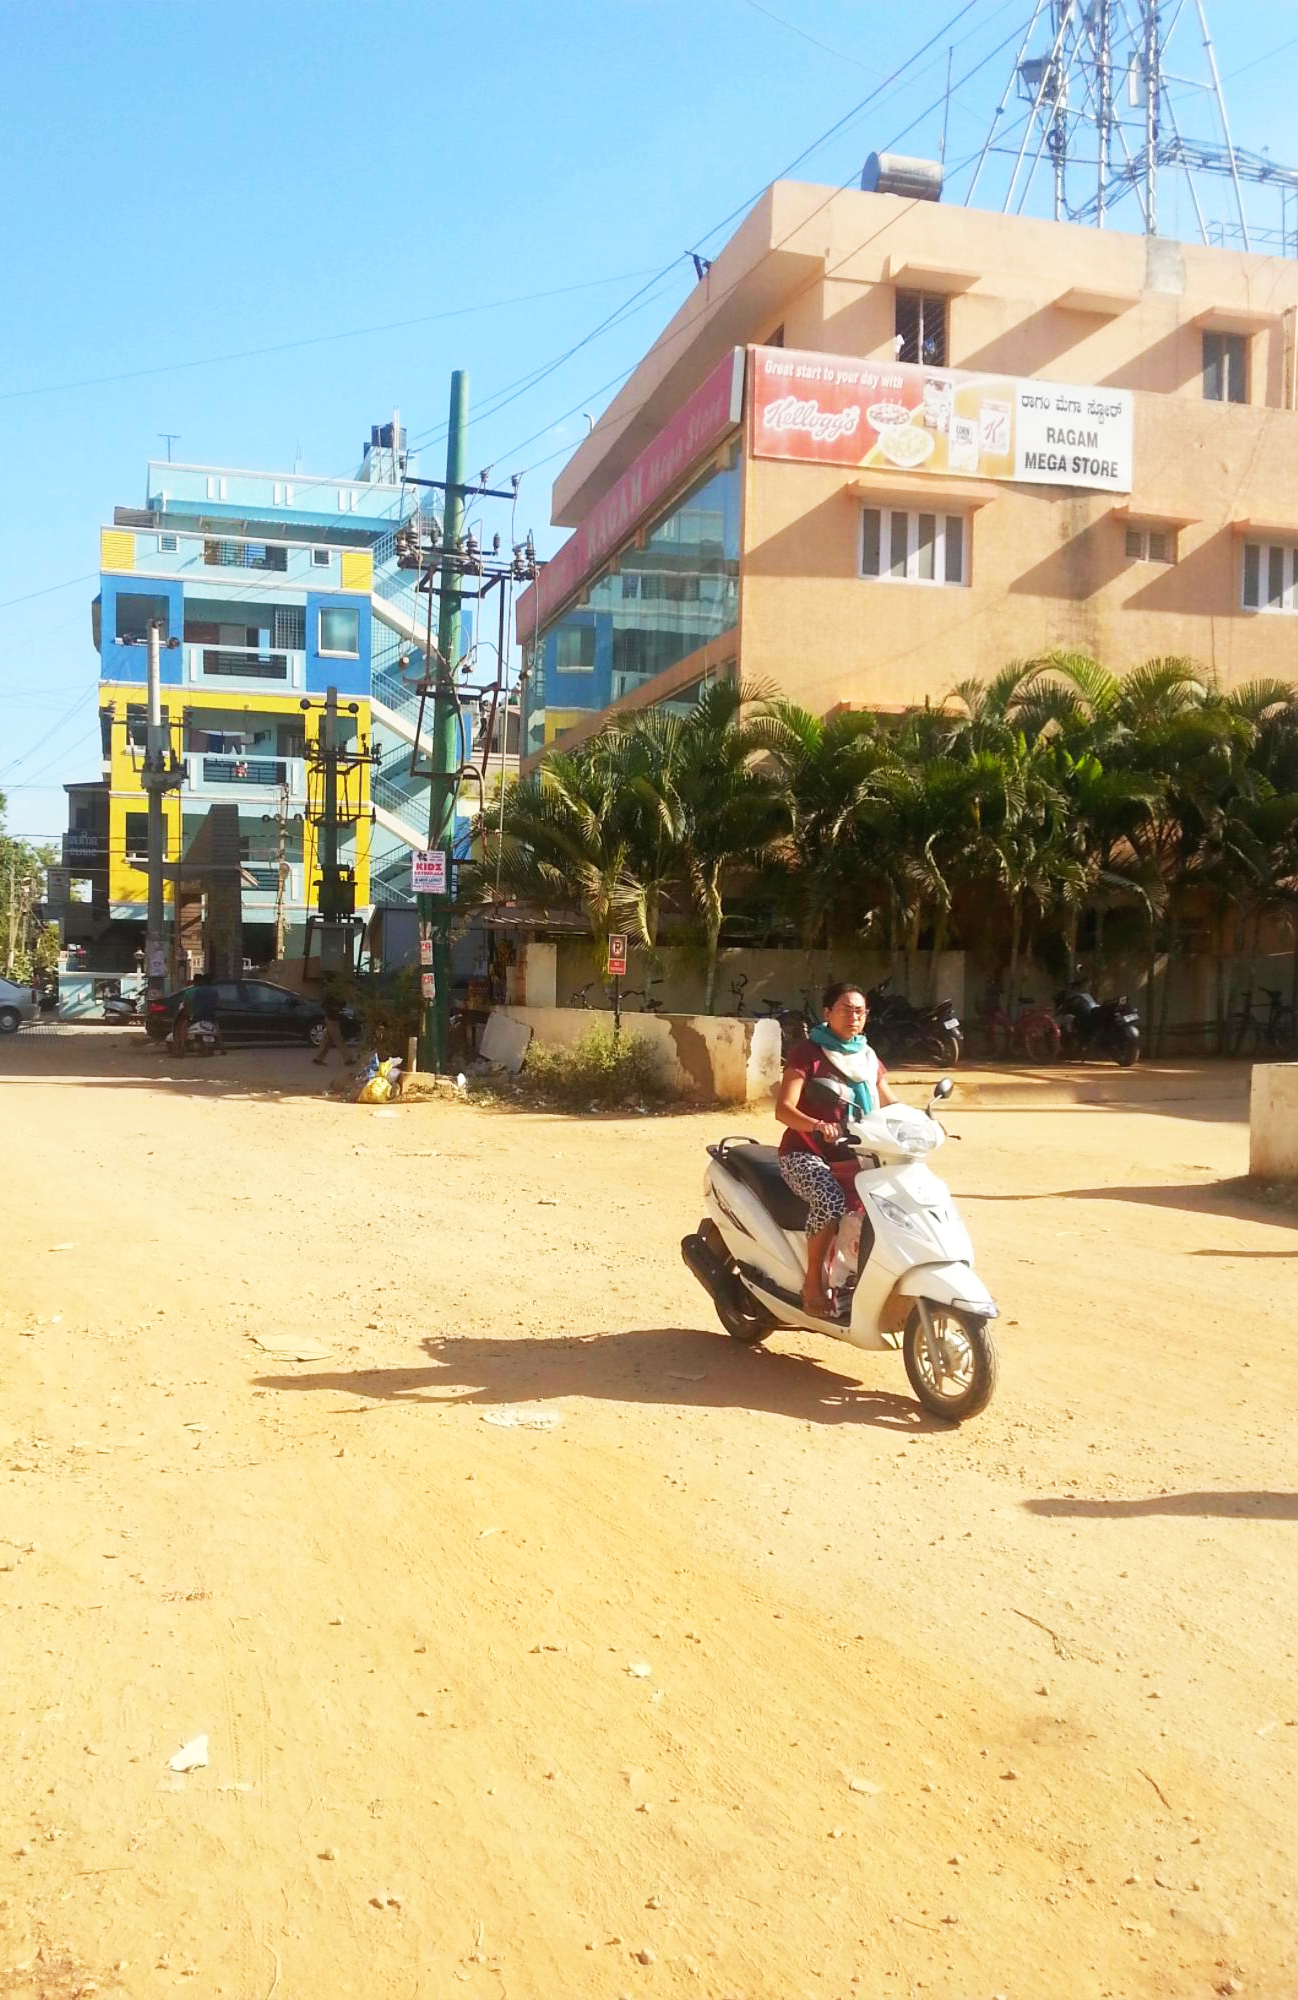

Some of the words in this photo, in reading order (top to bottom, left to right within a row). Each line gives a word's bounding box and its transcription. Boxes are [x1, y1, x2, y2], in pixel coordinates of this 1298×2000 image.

[765, 360, 794, 377] Great
[796, 366, 821, 381] start
[824, 368, 834, 381] to
[835, 370, 858, 385] your
[860, 371, 879, 389] day
[881, 374, 904, 389] with
[765, 397, 860, 441] Kellogg's
[1046, 427, 1098, 449] RAGAM
[1025, 452, 1067, 472] MEGA
[1072, 456, 1119, 478] STORE
[416, 863, 442, 871] KIDZ
